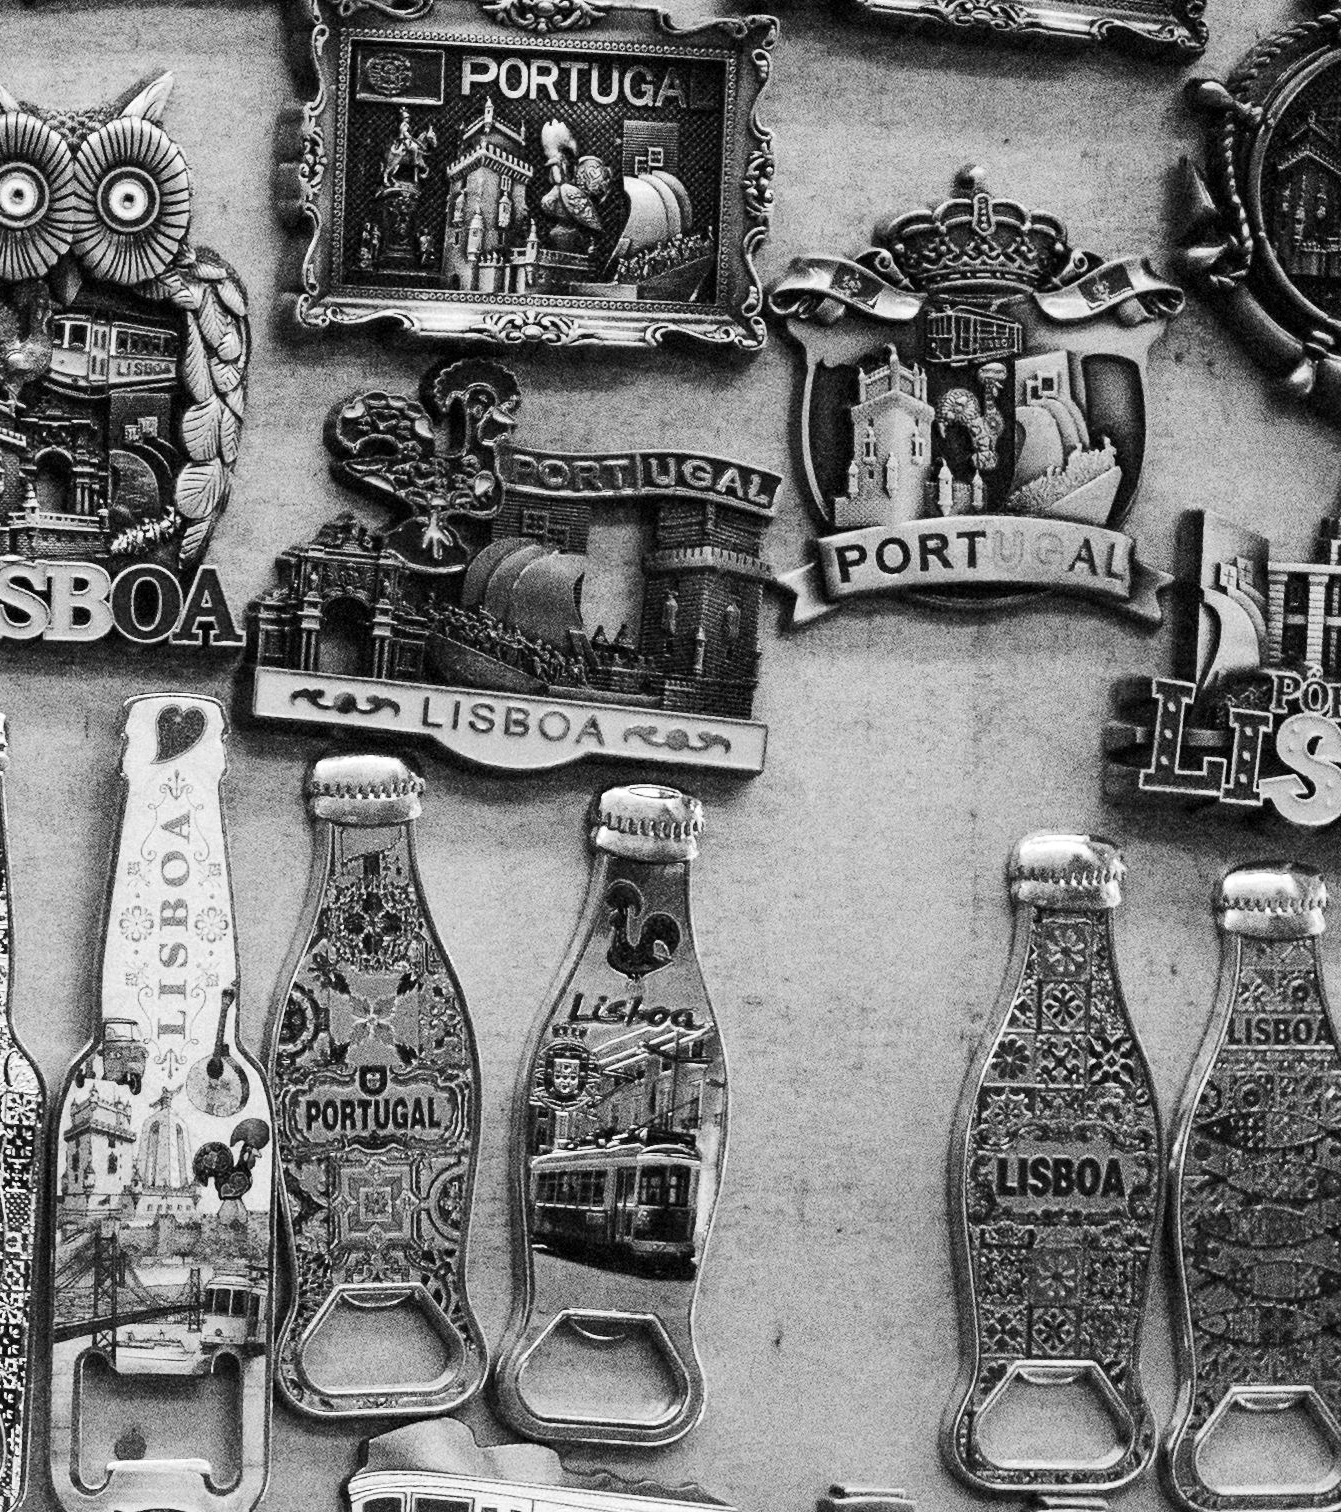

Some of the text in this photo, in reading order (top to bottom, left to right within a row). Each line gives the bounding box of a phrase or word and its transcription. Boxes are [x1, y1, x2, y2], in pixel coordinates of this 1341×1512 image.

[461, 55, 713, 109] PORTUGAL
[517, 456, 773, 507] PORTUGAL
[833, 530, 1128, 583] PORTUGAL
[422, 696, 606, 748] LISBOA
[157, 809, 191, 1040] LISBOA
[568, 990, 713, 1028] Lisboa
[1227, 1014, 1330, 1046] LISBOA
[305, 1095, 442, 1132] PORTUGAL
[995, 1156, 1125, 1197] LISBOA
